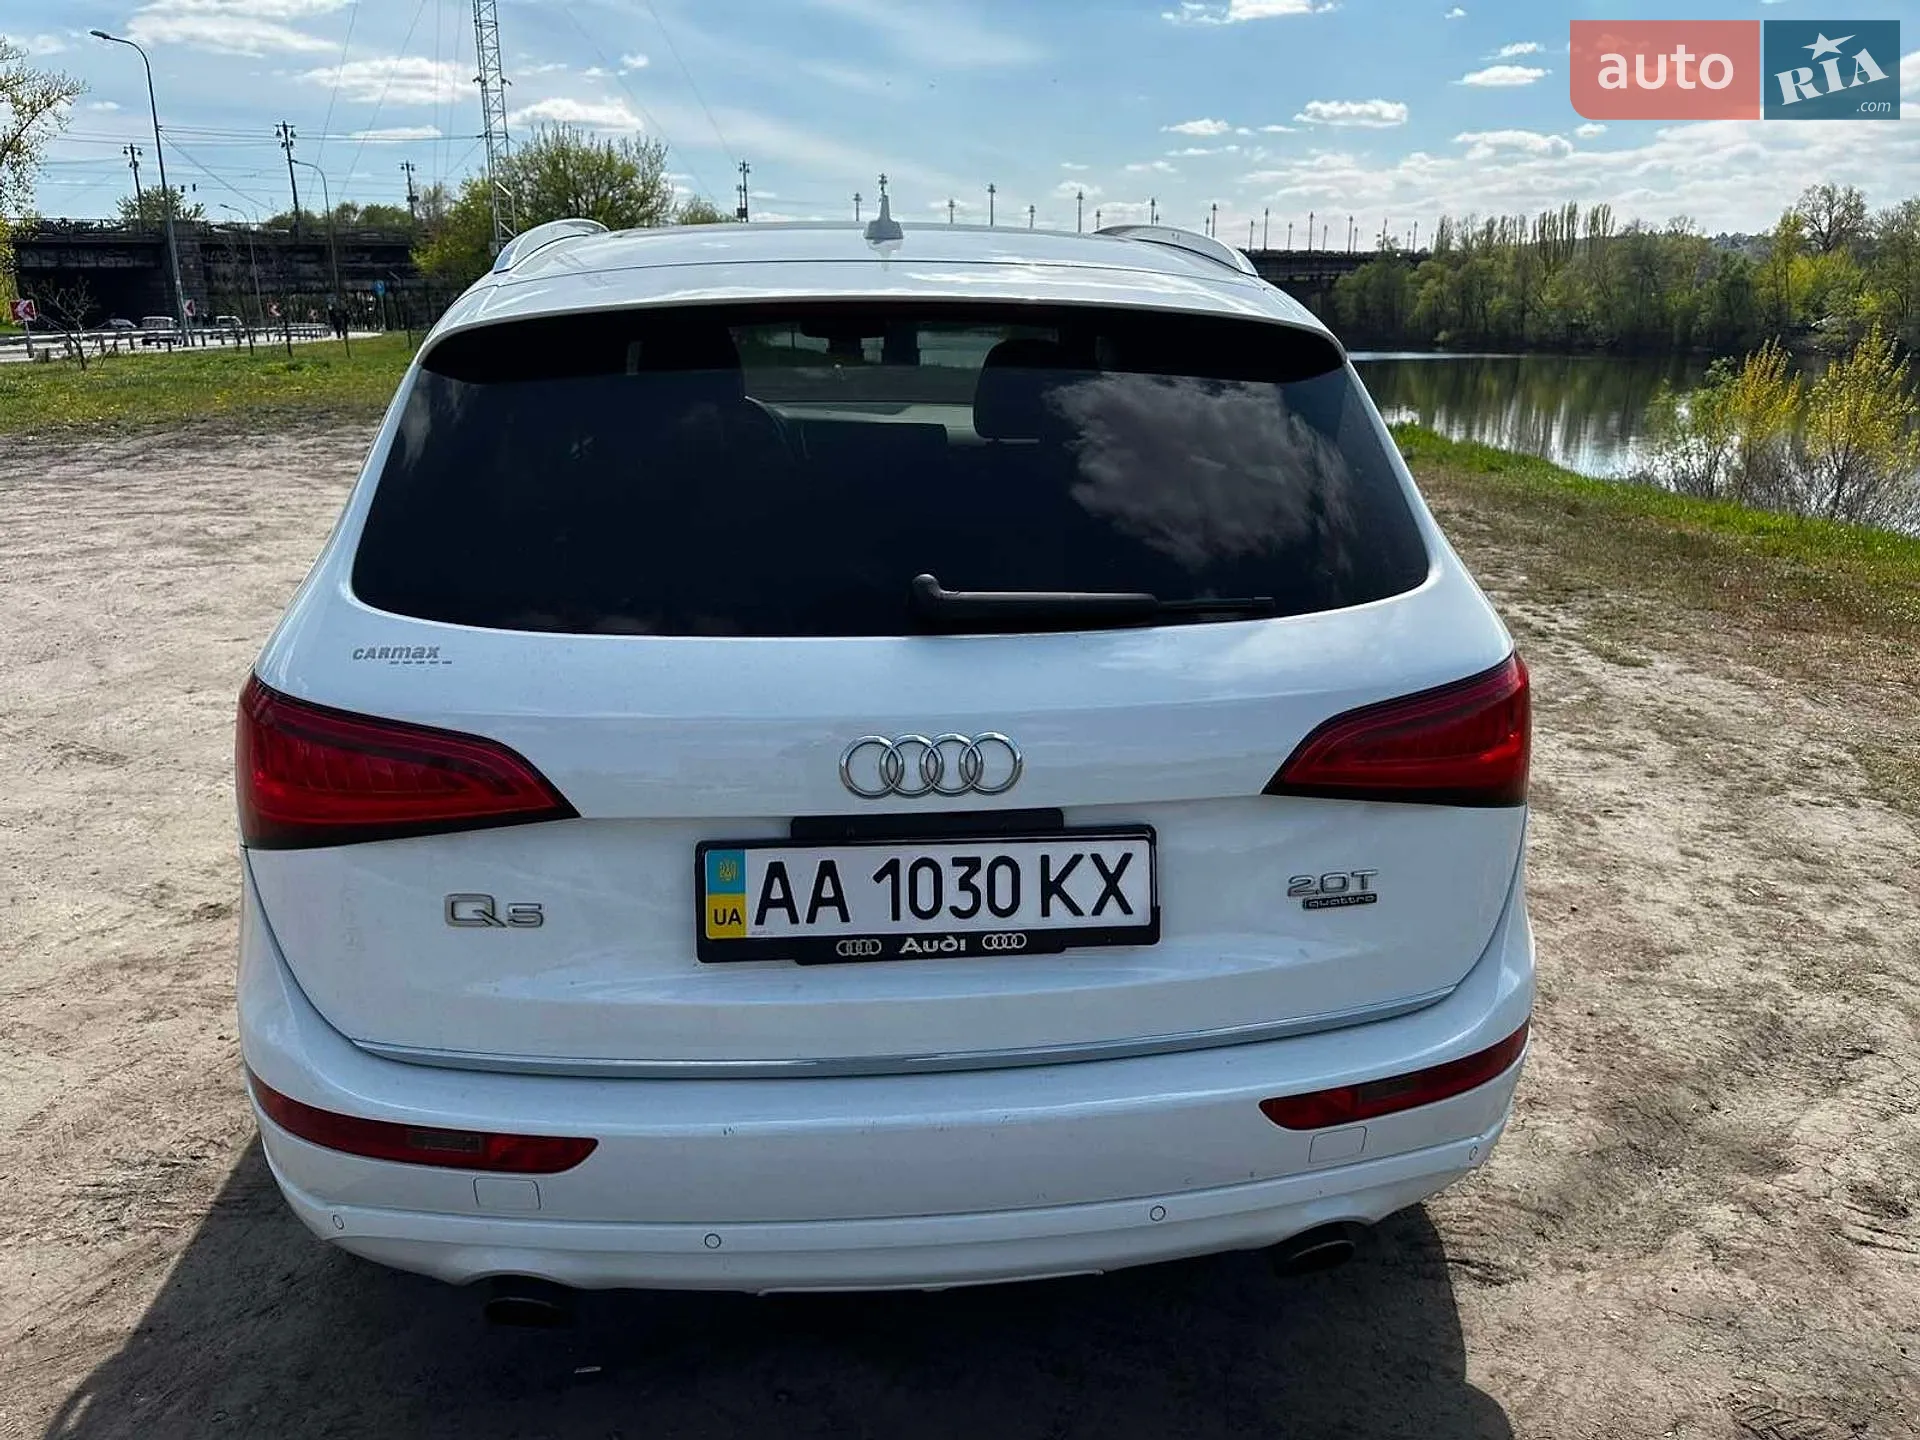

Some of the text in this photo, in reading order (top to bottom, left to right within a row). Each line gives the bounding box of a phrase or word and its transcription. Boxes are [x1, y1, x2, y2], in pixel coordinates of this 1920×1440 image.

[754, 852, 1134, 926] AA 1030 KX
[444, 893, 543, 928] Q5
[1306, 894, 1376, 910] quattro
[713, 908, 742, 925] UA
[899, 935, 966, 954] Audi
